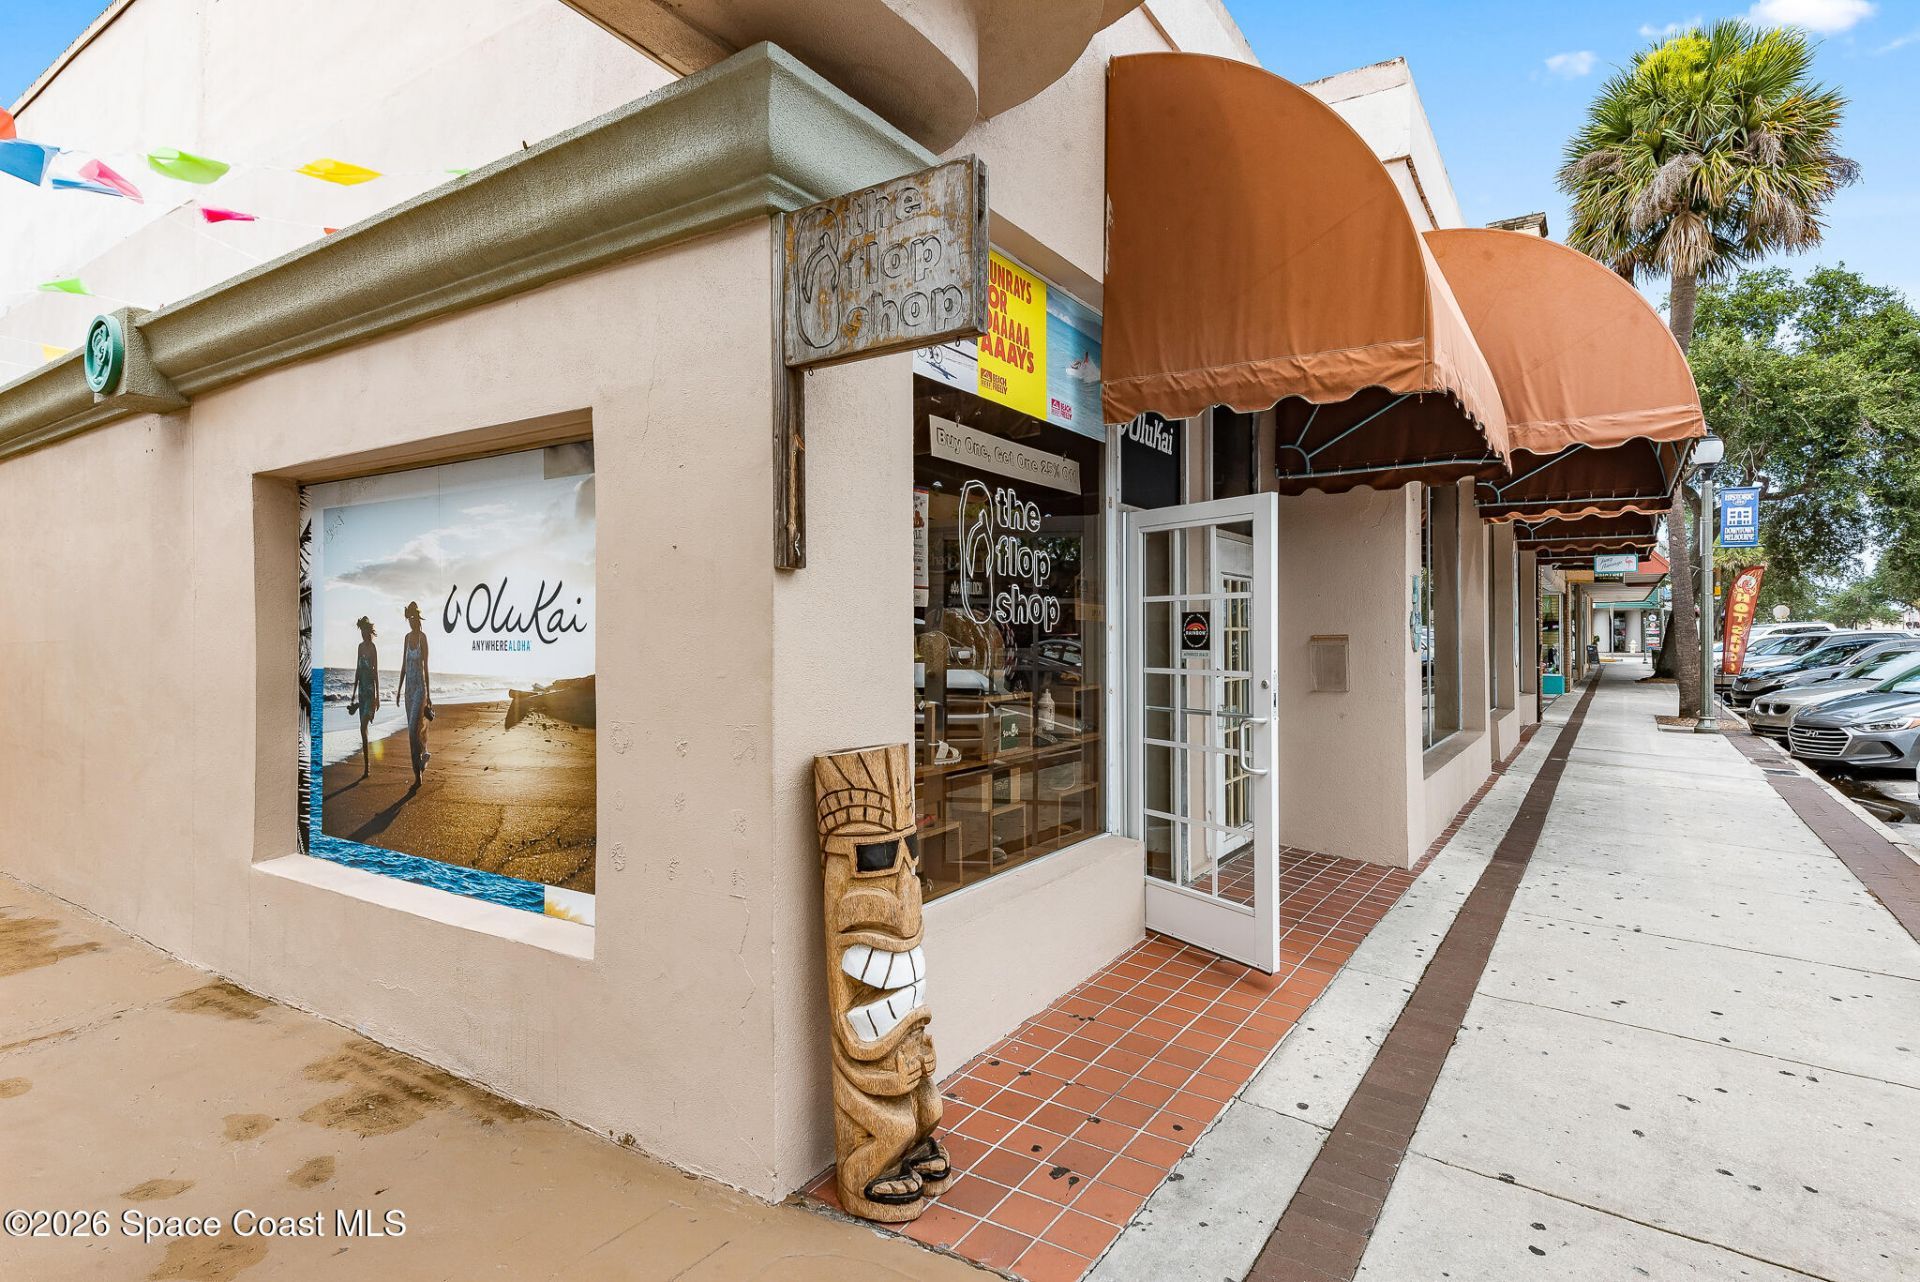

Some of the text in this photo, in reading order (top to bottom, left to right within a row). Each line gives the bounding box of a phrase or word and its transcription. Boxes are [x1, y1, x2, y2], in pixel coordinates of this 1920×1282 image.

[846, 187, 923, 236] the
[846, 235, 942, 289] flop
[989, 259, 1032, 304] UNRAYS
[846, 284, 963, 339] shop
[987, 285, 1008, 314] OR
[981, 332, 1034, 373] AAAYS
[936, 427, 962, 454] Buy
[964, 436, 991, 463] One,
[994, 446, 1014, 466] Get
[1017, 453, 1039, 472] One
[1041, 460, 1061, 479] 25%
[1129, 412, 1173, 455] OluKai
[995, 488, 1041, 533] the
[995, 536, 1051, 588] flop
[466, 576, 587, 644] OluKai
[995, 584, 1061, 632] shop
